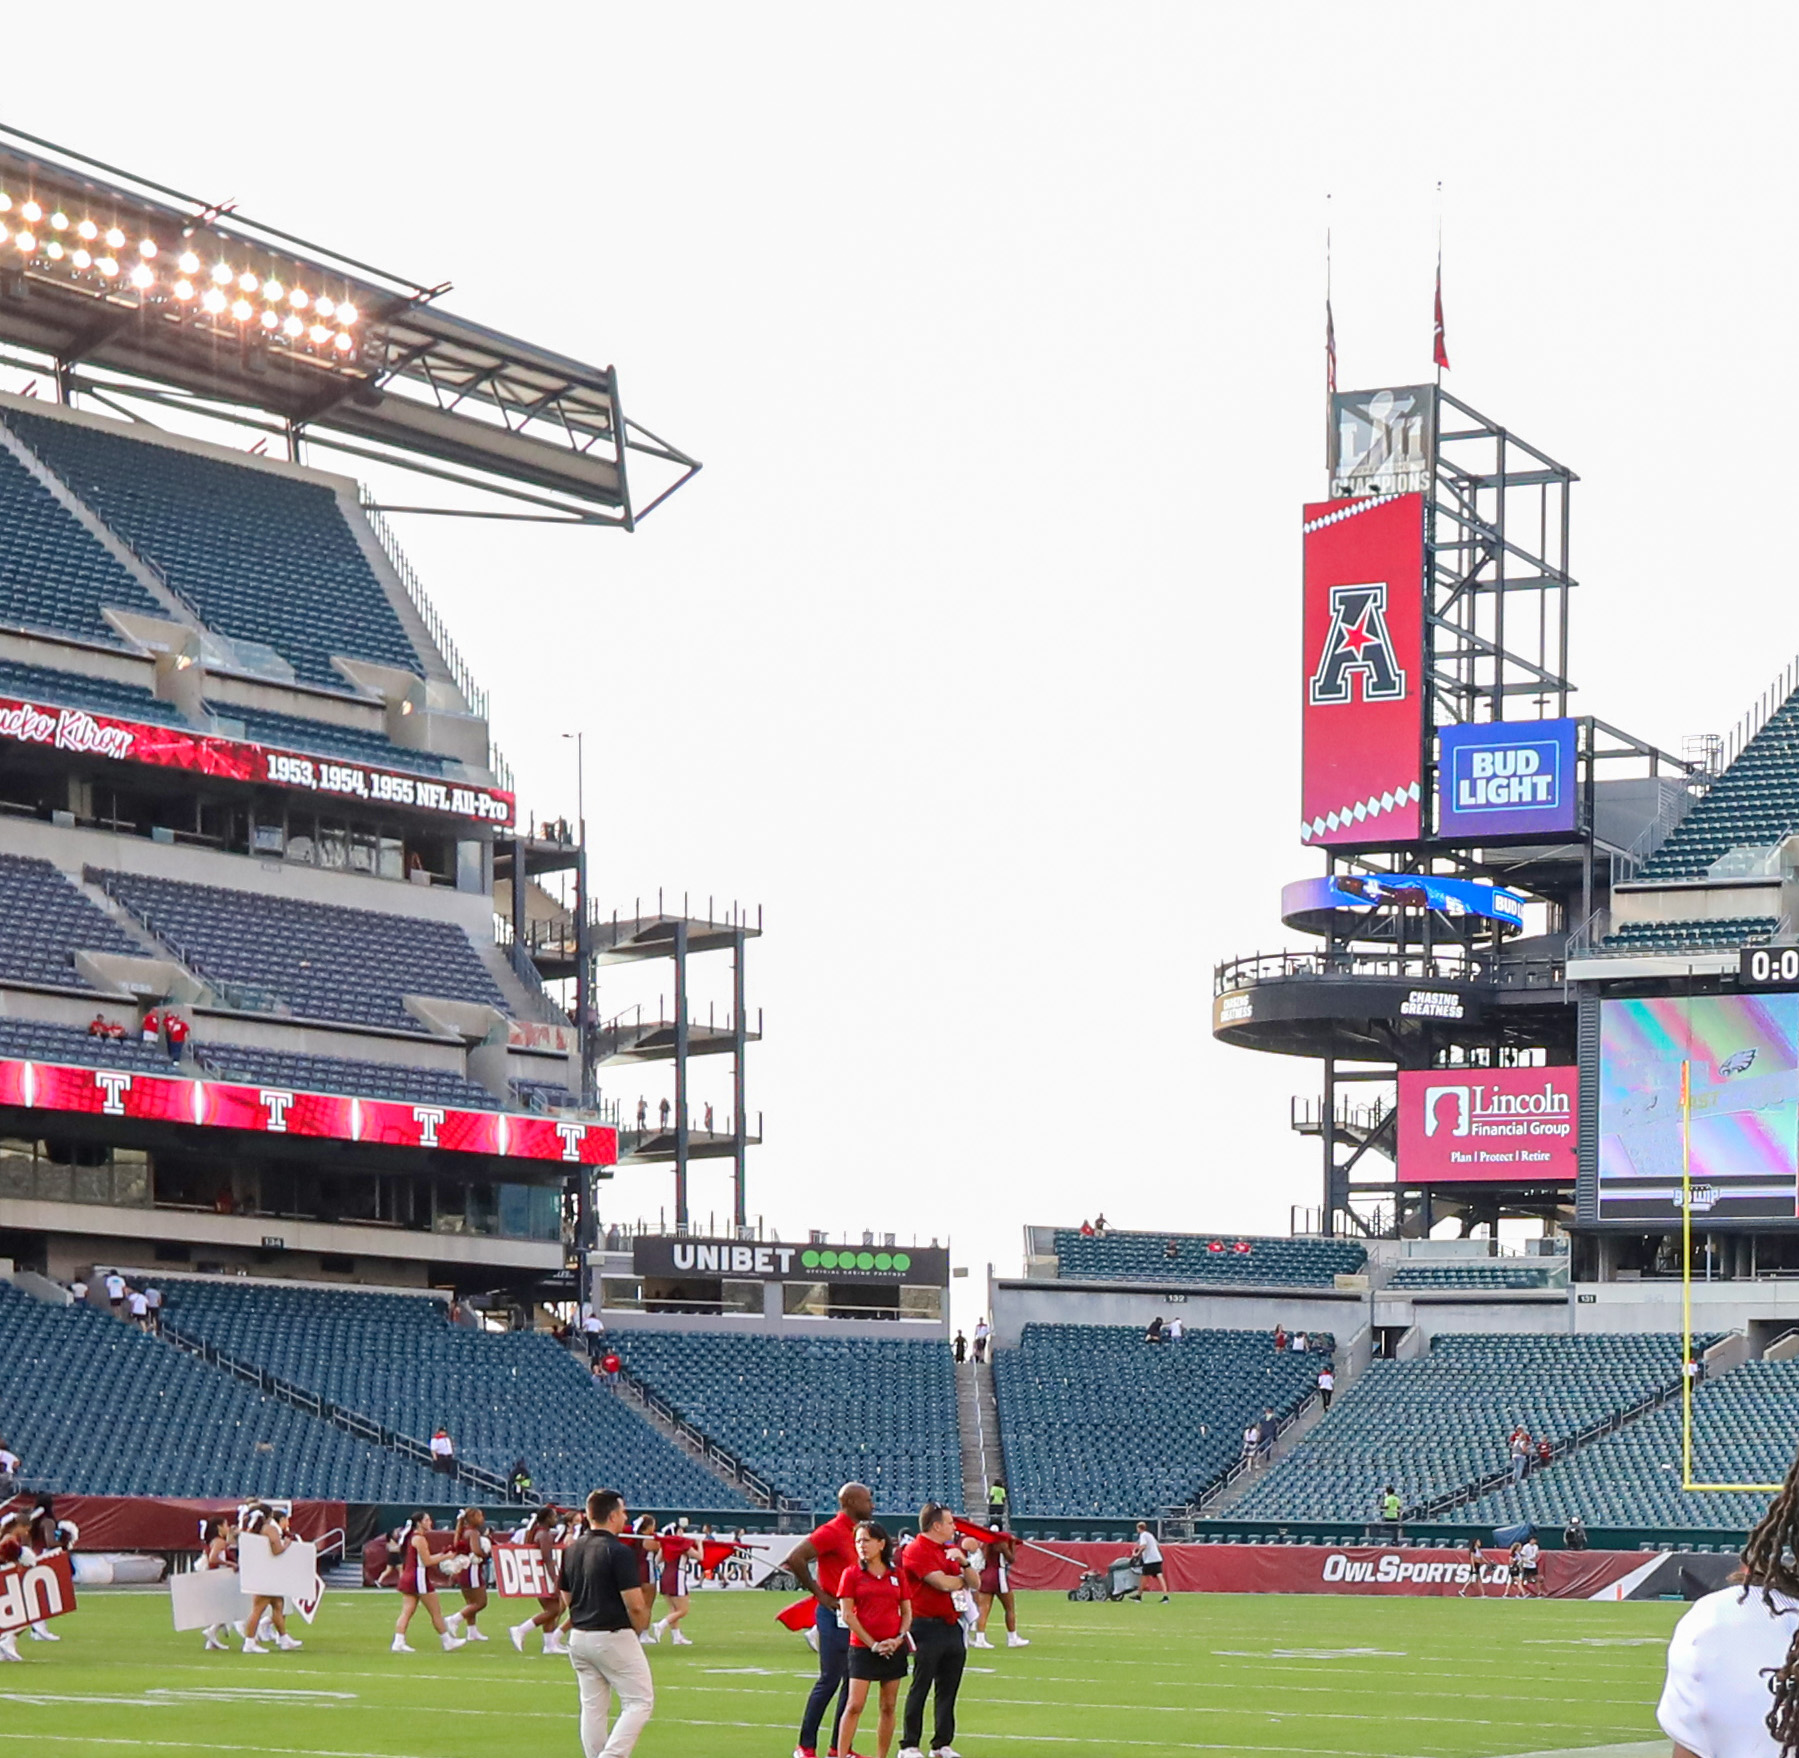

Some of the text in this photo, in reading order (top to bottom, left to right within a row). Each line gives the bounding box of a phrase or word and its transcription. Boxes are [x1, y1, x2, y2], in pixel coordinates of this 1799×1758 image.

[0, 703, 133, 759] ucko Kilroy
[1472, 749, 1540, 777] BUD
[267, 755, 508, 820] 1953, 1954, 1955 NFL All-Pro
[1459, 775, 1552, 805] LIGHT
[1494, 893, 1517, 915] BUD
[1400, 1001, 1464, 1018] GREATNESS
[1409, 990, 1459, 1006] CHASING
[1472, 1083, 1570, 1114] Lincoln
[1472, 1121, 1570, 1137] Financial Group
[1451, 1150, 1550, 1162] Plan Protect Retire
[673, 1244, 795, 1273] UNIBET
